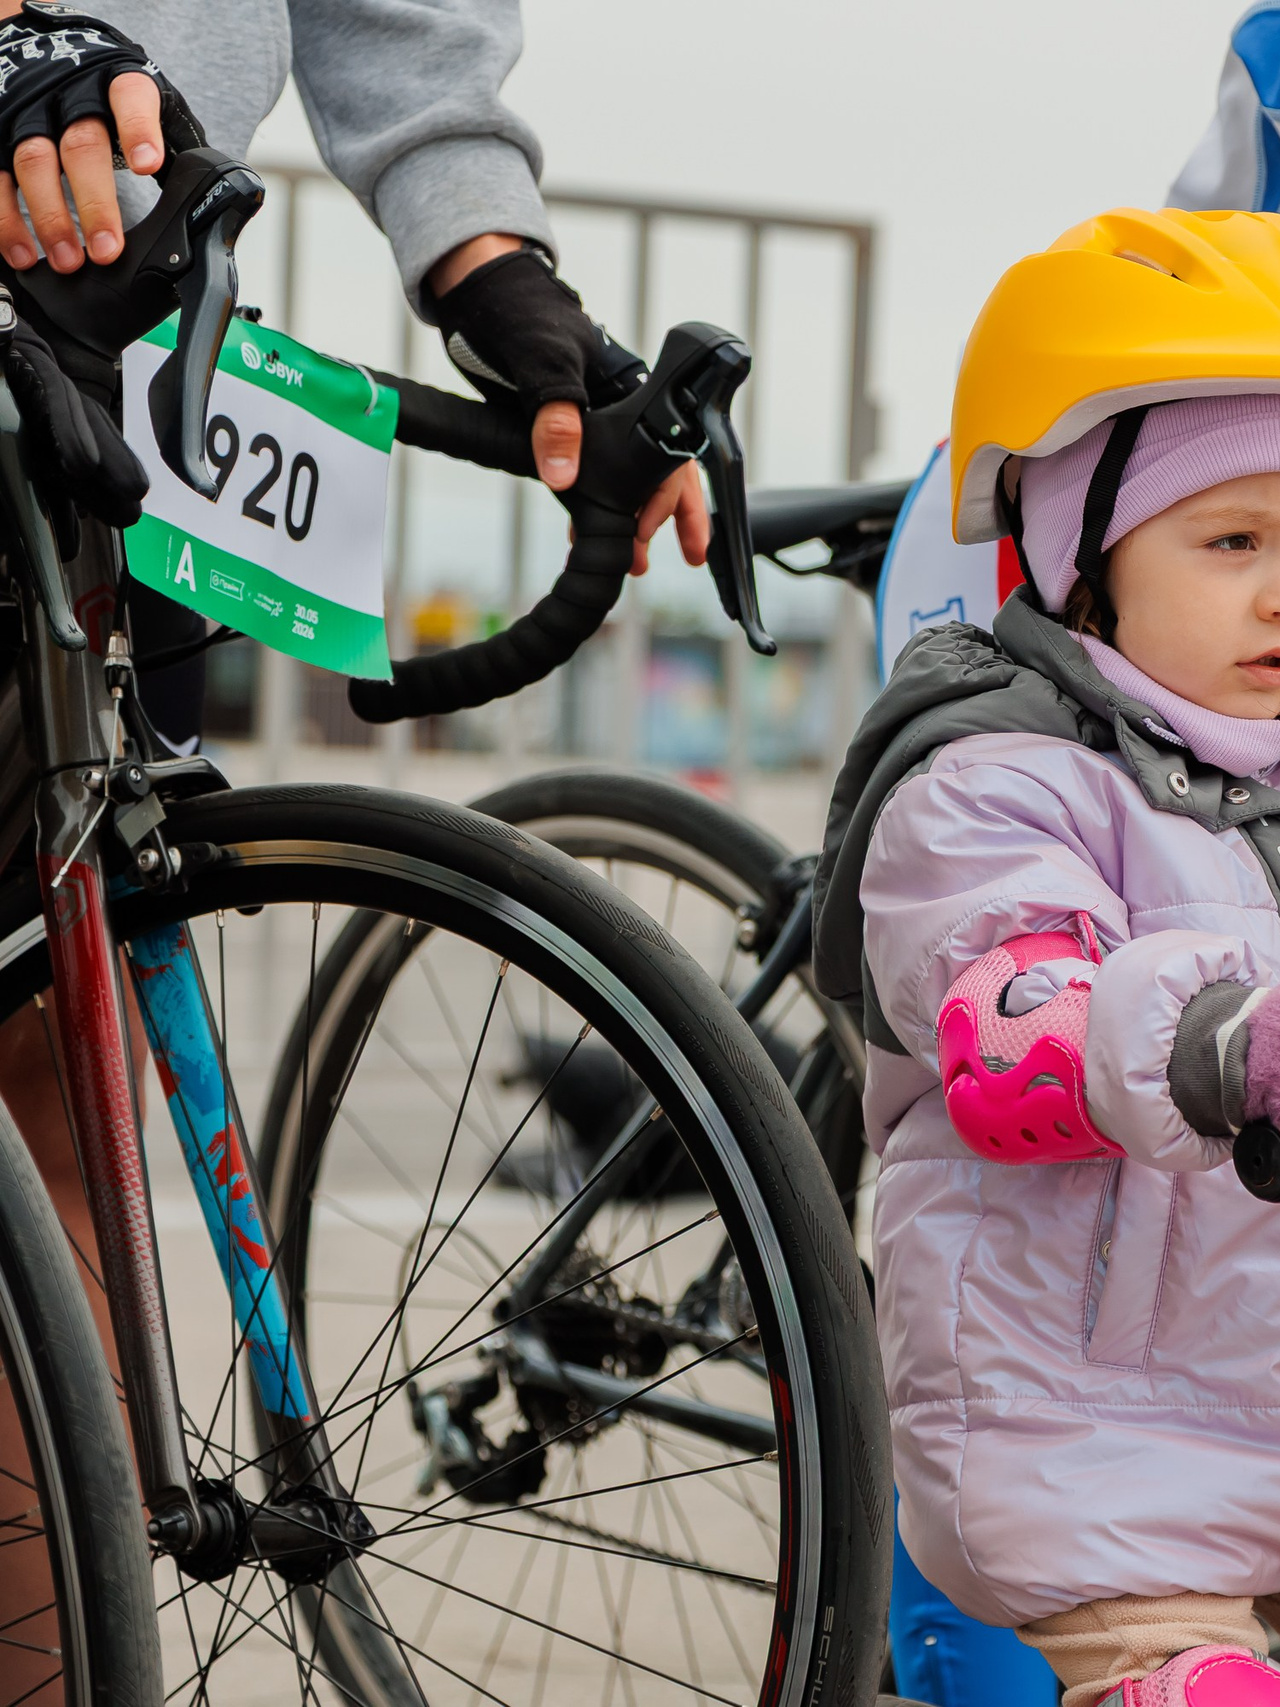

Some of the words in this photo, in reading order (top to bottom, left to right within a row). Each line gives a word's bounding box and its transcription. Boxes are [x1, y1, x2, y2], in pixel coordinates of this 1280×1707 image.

[205, 413, 320, 543] 920
[173, 540, 197, 593] A
[291, 620, 316, 641] 2026
[294, 603, 319, 625] 30.05
